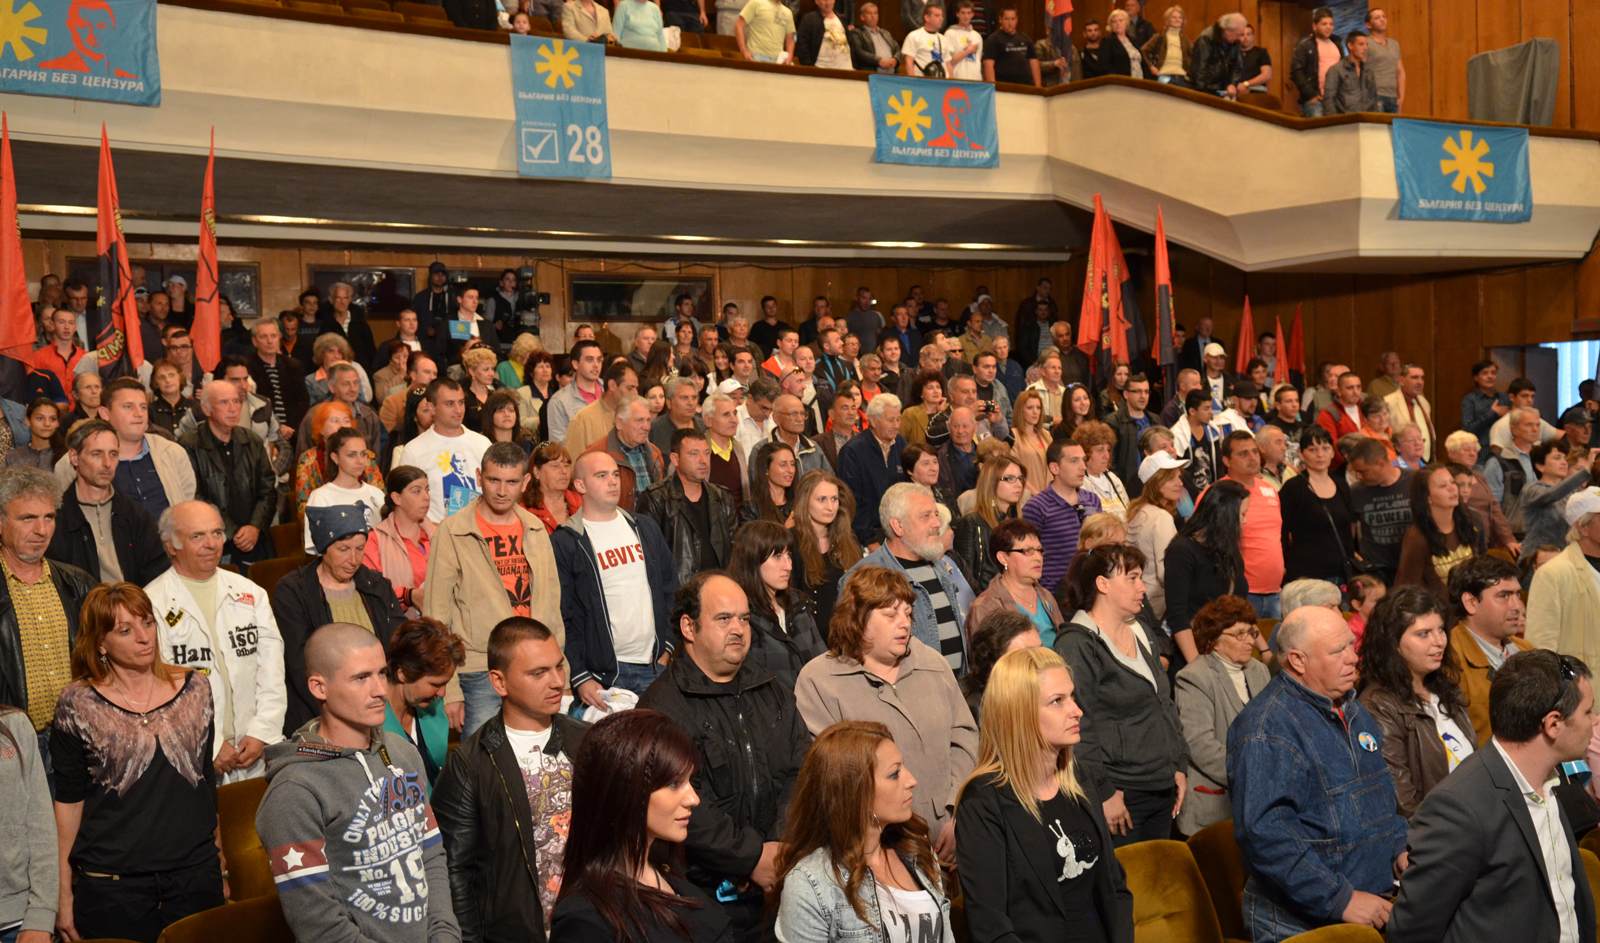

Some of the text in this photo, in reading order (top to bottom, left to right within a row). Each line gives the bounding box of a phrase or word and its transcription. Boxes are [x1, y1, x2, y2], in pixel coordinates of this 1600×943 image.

[52, 72, 77, 84] БЕЗ
[82, 75, 144, 92] ЦЕНЗУРА
[518, 91, 602, 105] БЪЛГАРИЯ БЕЗ ЦЕНЗУРА
[567, 124, 603, 164] 28
[892, 146, 991, 159] БЪЛГАРИЯ БЕЗ ЦЕНЗУРА
[1418, 199, 1524, 212] БЪЛГАРИЯ БЕЗ ЦЕНЗУРА
[485, 535, 525, 557] TEX
[342, 799, 372, 843] ONLY
